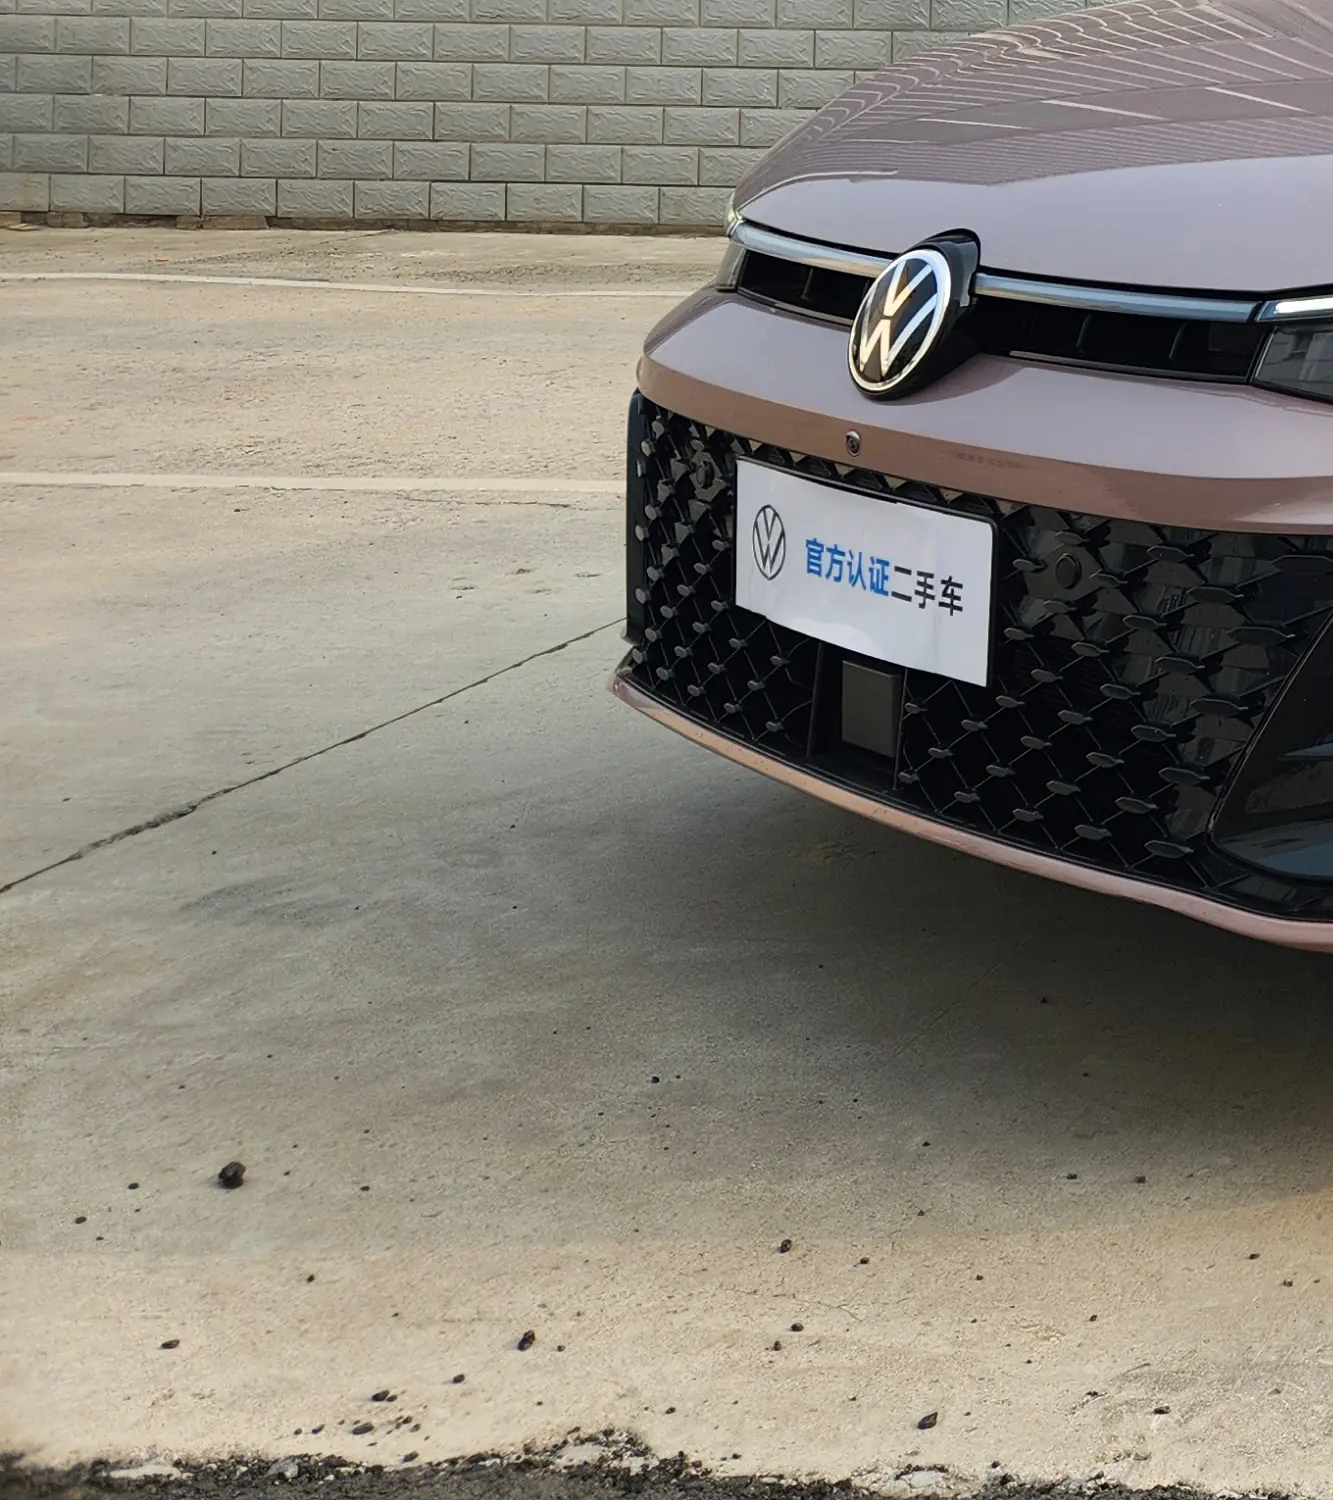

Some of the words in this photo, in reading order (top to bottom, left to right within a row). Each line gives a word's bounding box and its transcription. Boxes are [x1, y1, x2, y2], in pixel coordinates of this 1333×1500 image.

[804, 537, 964, 616] 官方认证二手车
